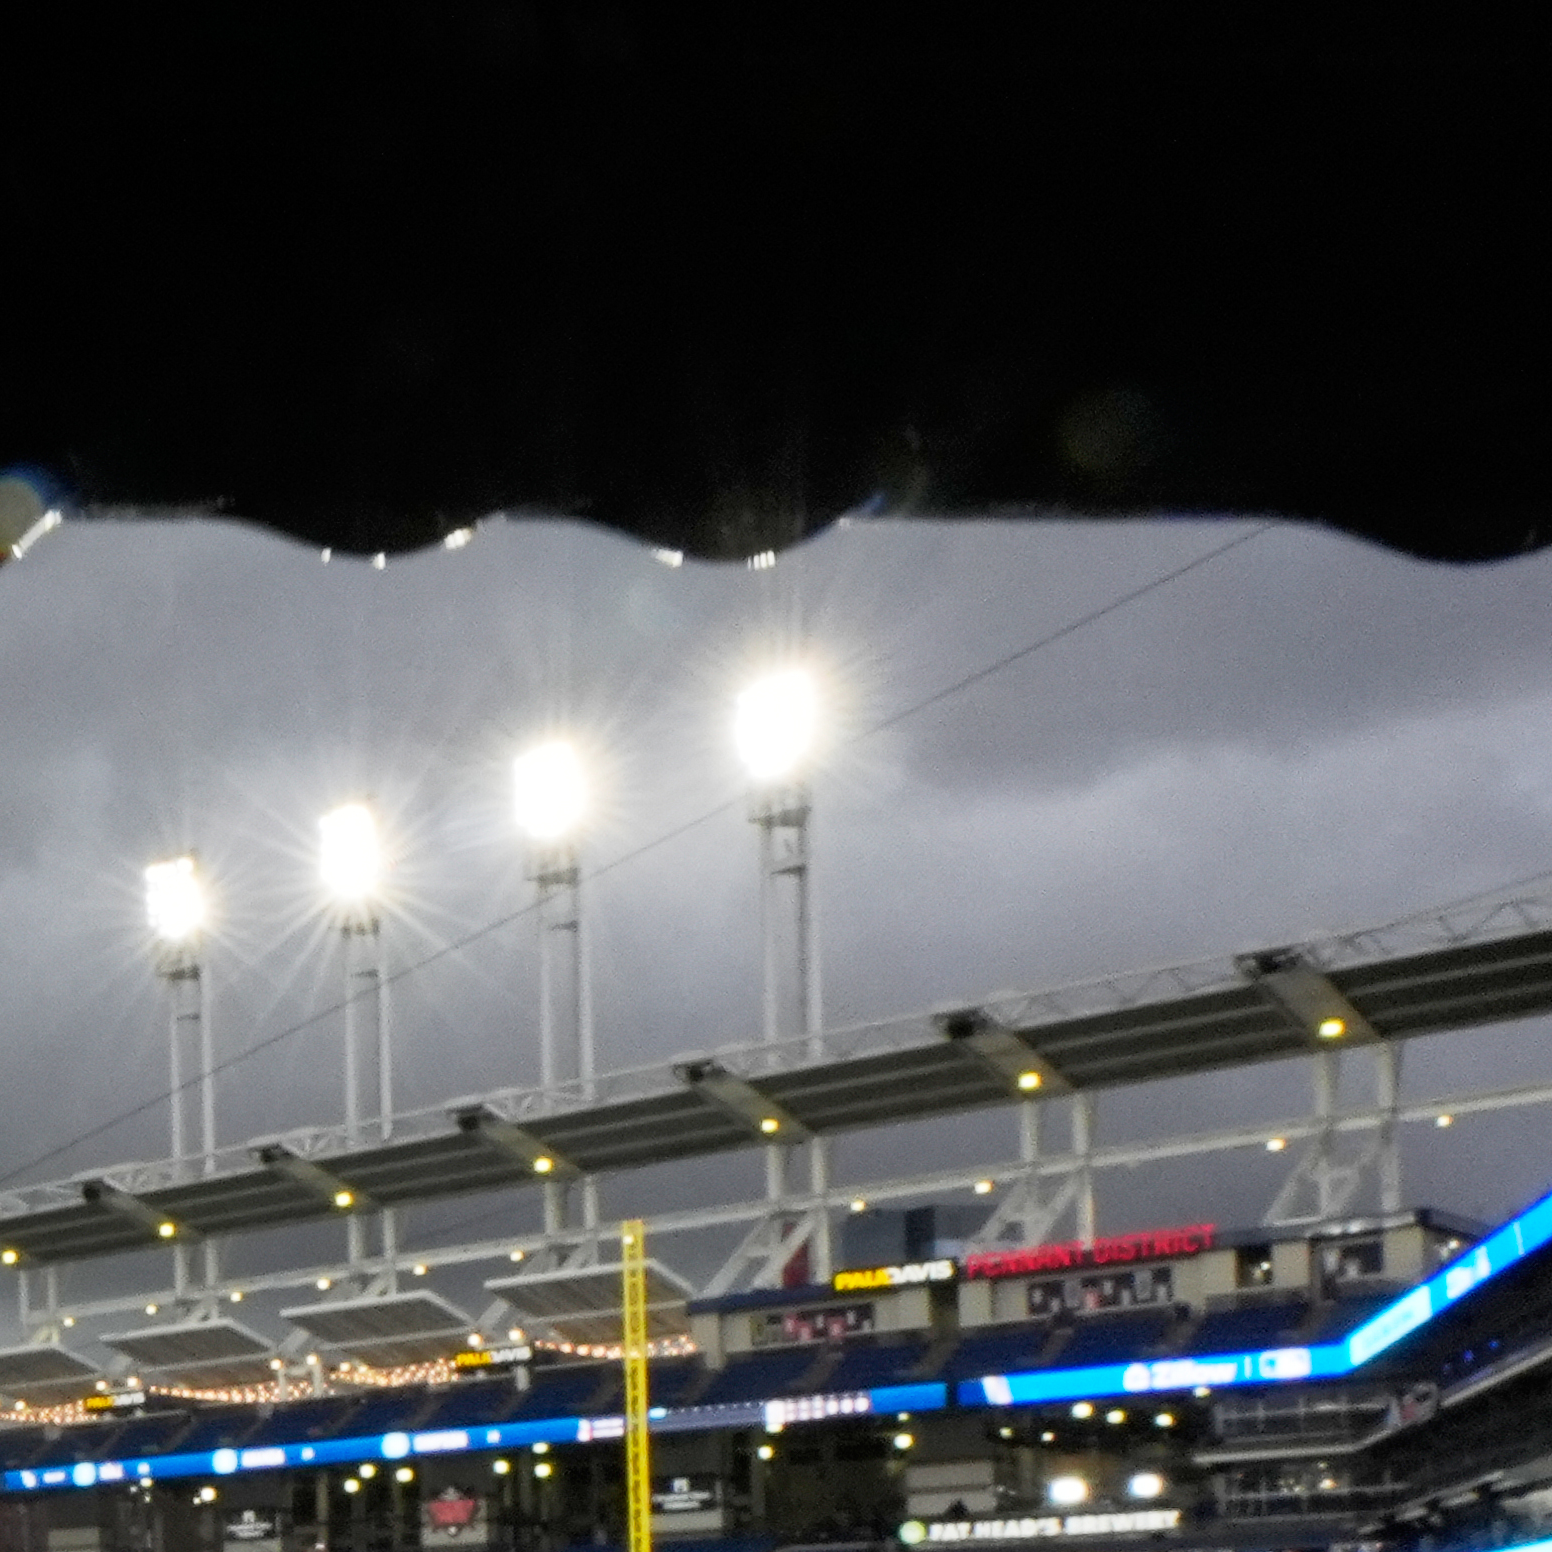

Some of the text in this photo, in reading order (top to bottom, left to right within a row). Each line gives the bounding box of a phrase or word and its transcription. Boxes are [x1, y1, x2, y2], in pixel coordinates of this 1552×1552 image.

[1094, 1222, 1214, 1265] DISTRICT
[1151, 1361, 1237, 1388] Zillow
[927, 1521, 971, 1542] FAT
[1064, 1508, 1182, 1537] BREWERY
